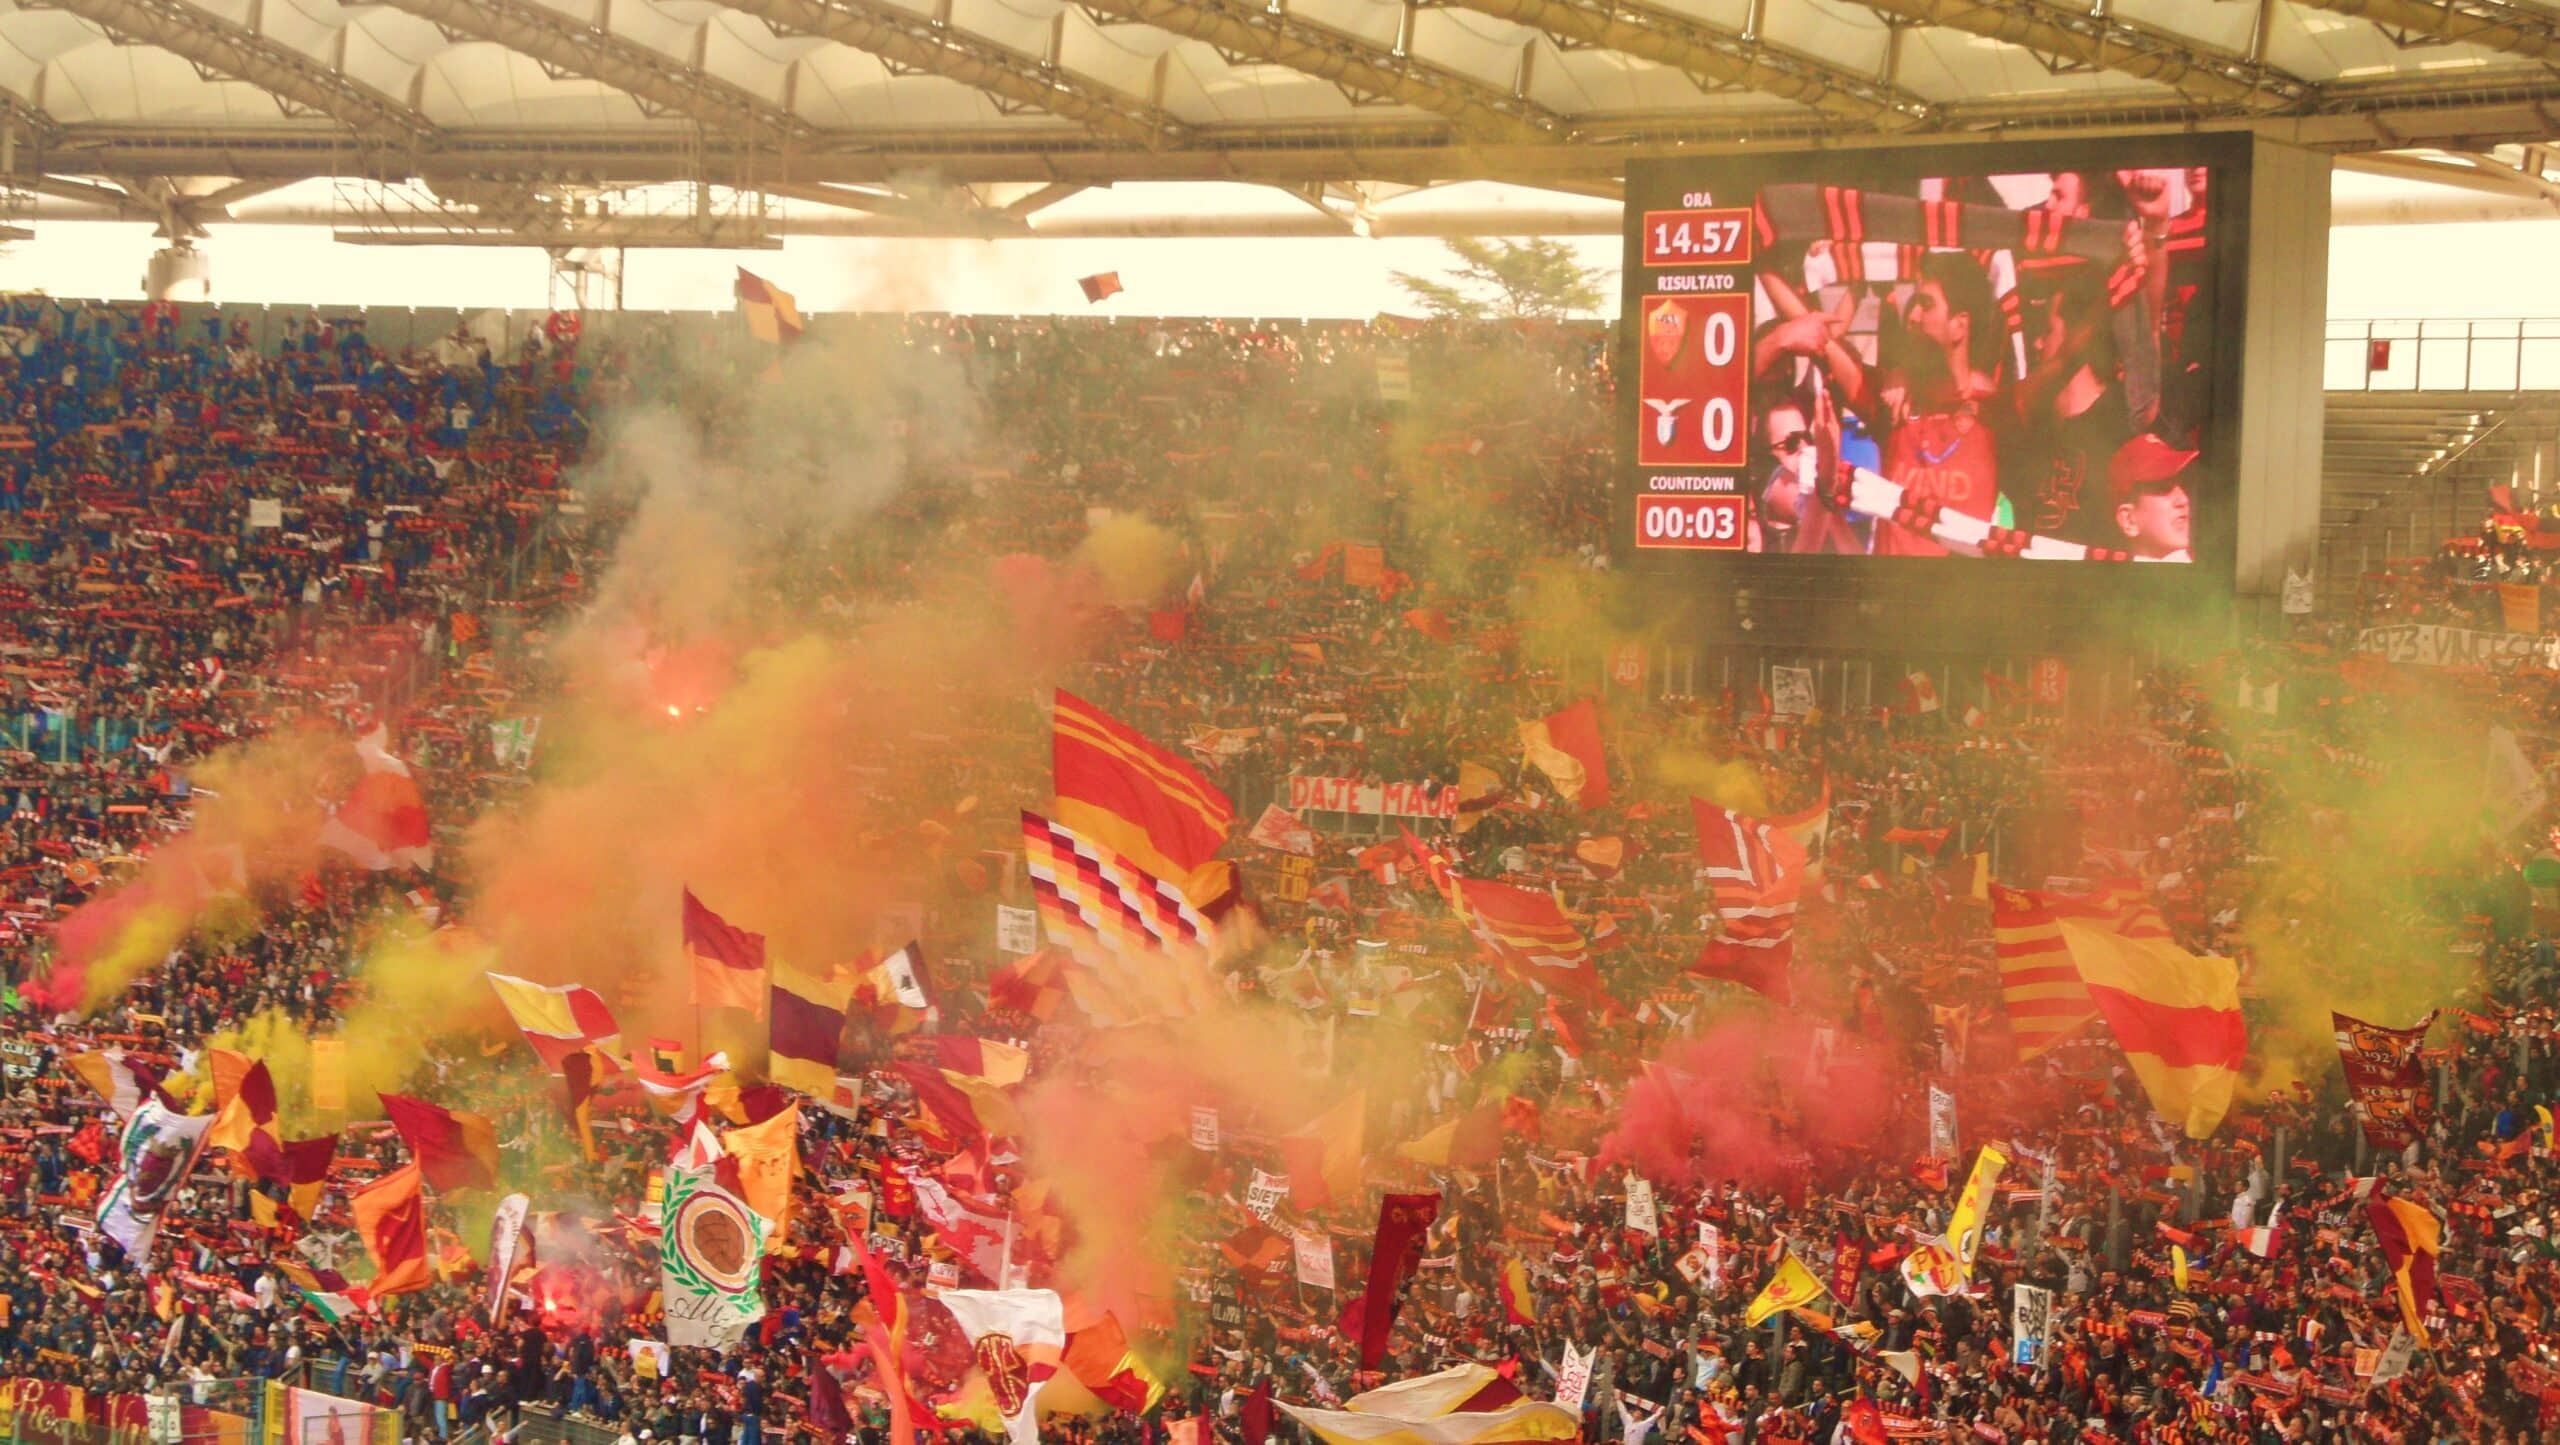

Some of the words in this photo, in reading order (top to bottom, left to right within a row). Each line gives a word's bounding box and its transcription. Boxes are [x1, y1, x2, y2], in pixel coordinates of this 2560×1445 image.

[1683, 192, 1713, 208] ORA
[1655, 220, 1742, 255] 14.57
[1657, 274, 1735, 292] RISULTATO
[1703, 311, 1736, 367] 0
[1702, 397, 1734, 452] 0
[1649, 476, 1735, 491] COUNTDOWN
[1645, 506, 1735, 540] 00:03
[1290, 775, 1362, 814] DAJE
